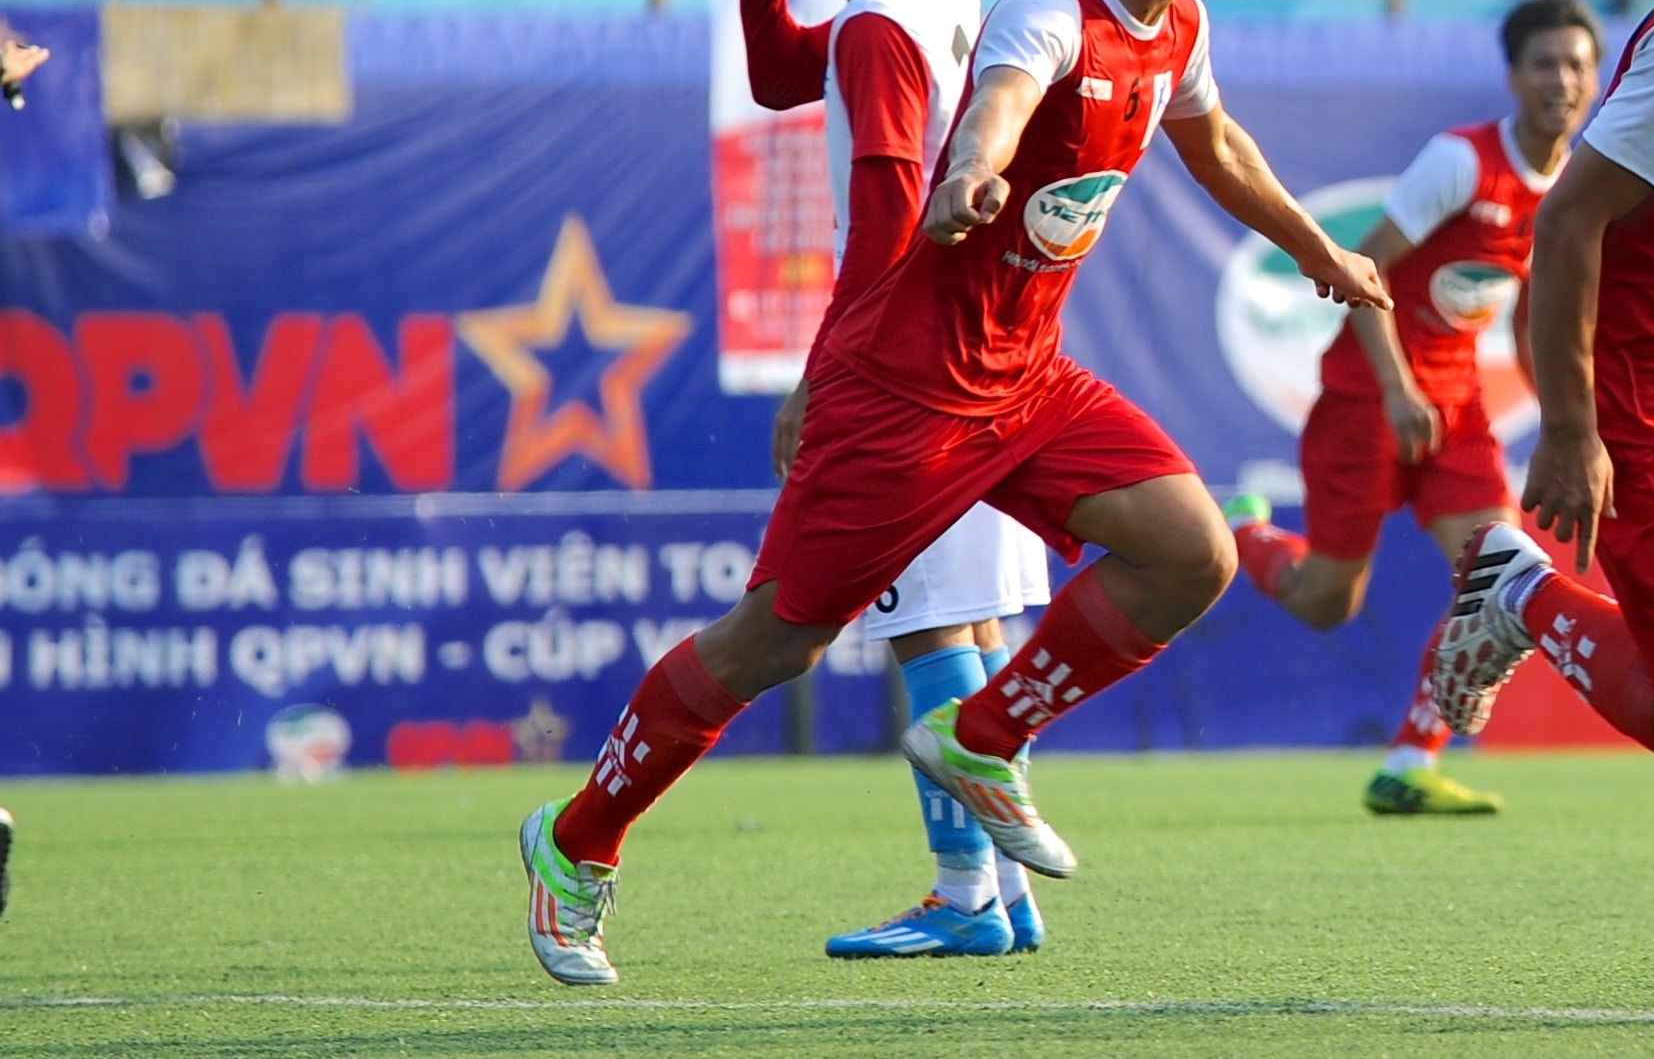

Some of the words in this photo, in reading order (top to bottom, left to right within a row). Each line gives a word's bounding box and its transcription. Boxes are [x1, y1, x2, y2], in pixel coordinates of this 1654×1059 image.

[1123, 77, 1139, 122] 6
[1039, 199, 1106, 226] VIETT
[0, 309, 453, 494] QPVN
[0, 536, 160, 614] ÓNG
[290, 545, 469, 611] SINH
[478, 530, 648, 607] VIÊN
[659, 542, 756, 604] TO
[28, 613, 217, 689] HÌNH
[230, 623, 427, 696] QPVN
[483, 606, 627, 682] CÚP
